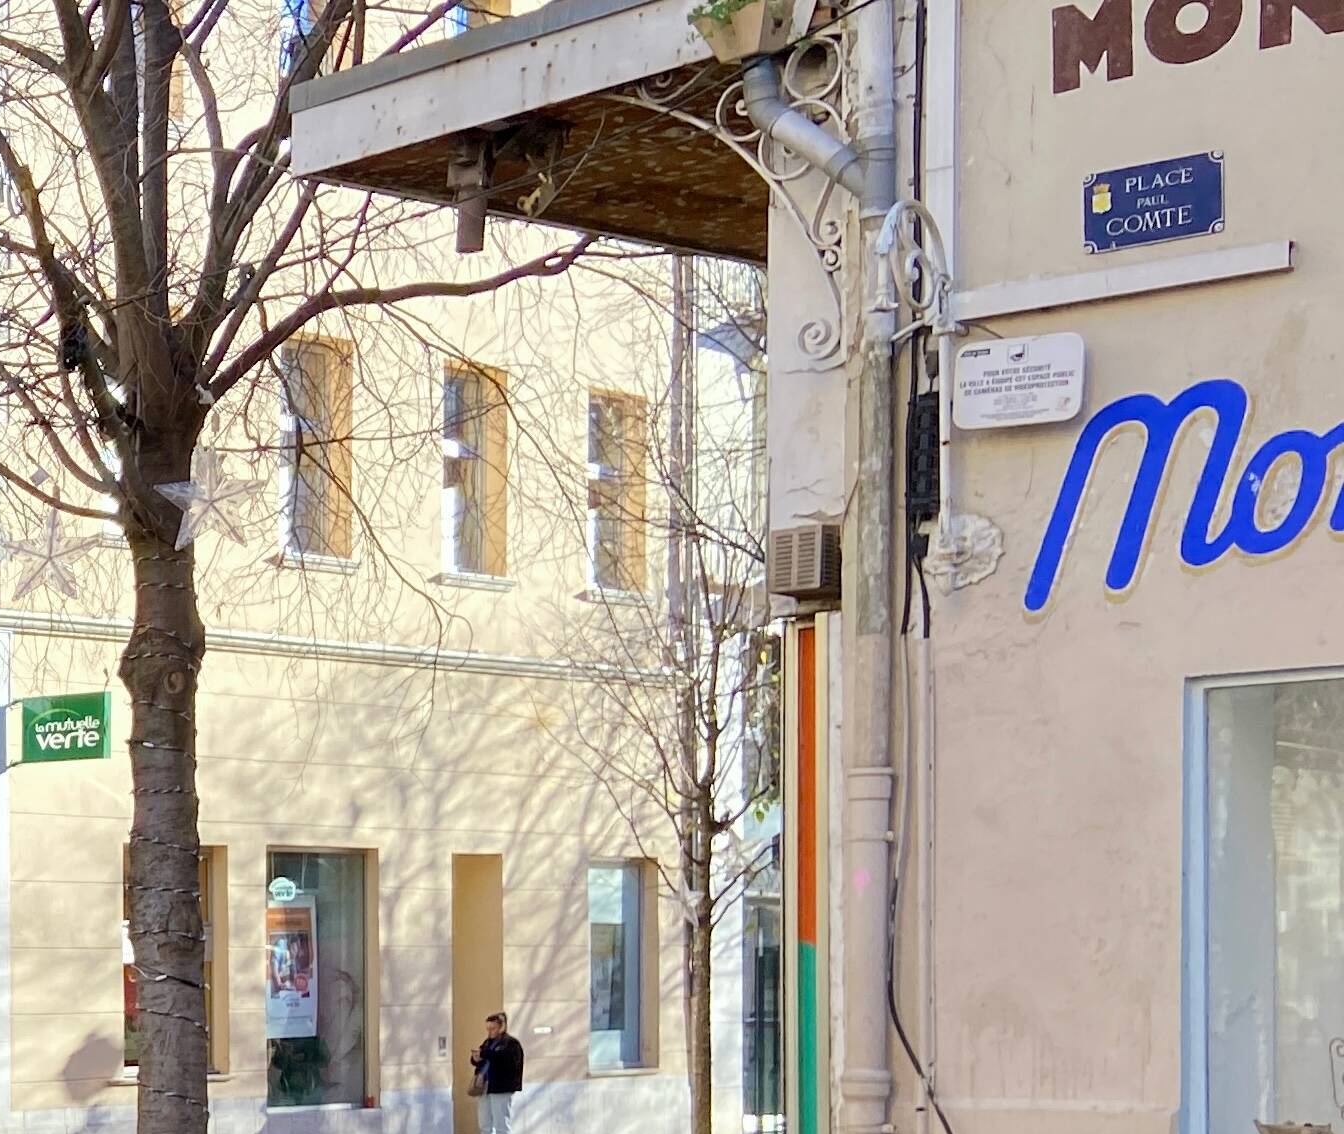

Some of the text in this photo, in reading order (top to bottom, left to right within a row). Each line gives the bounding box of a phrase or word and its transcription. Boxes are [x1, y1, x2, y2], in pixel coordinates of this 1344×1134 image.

[1125, 167, 1194, 193] PLACE
[1137, 194, 1168, 209] PAUL
[1106, 204, 1193, 236] COMTE
[1024, 379, 1344, 612] Mo
[35, 715, 100, 733] la mutuelle
[35, 729, 100, 751] verte
